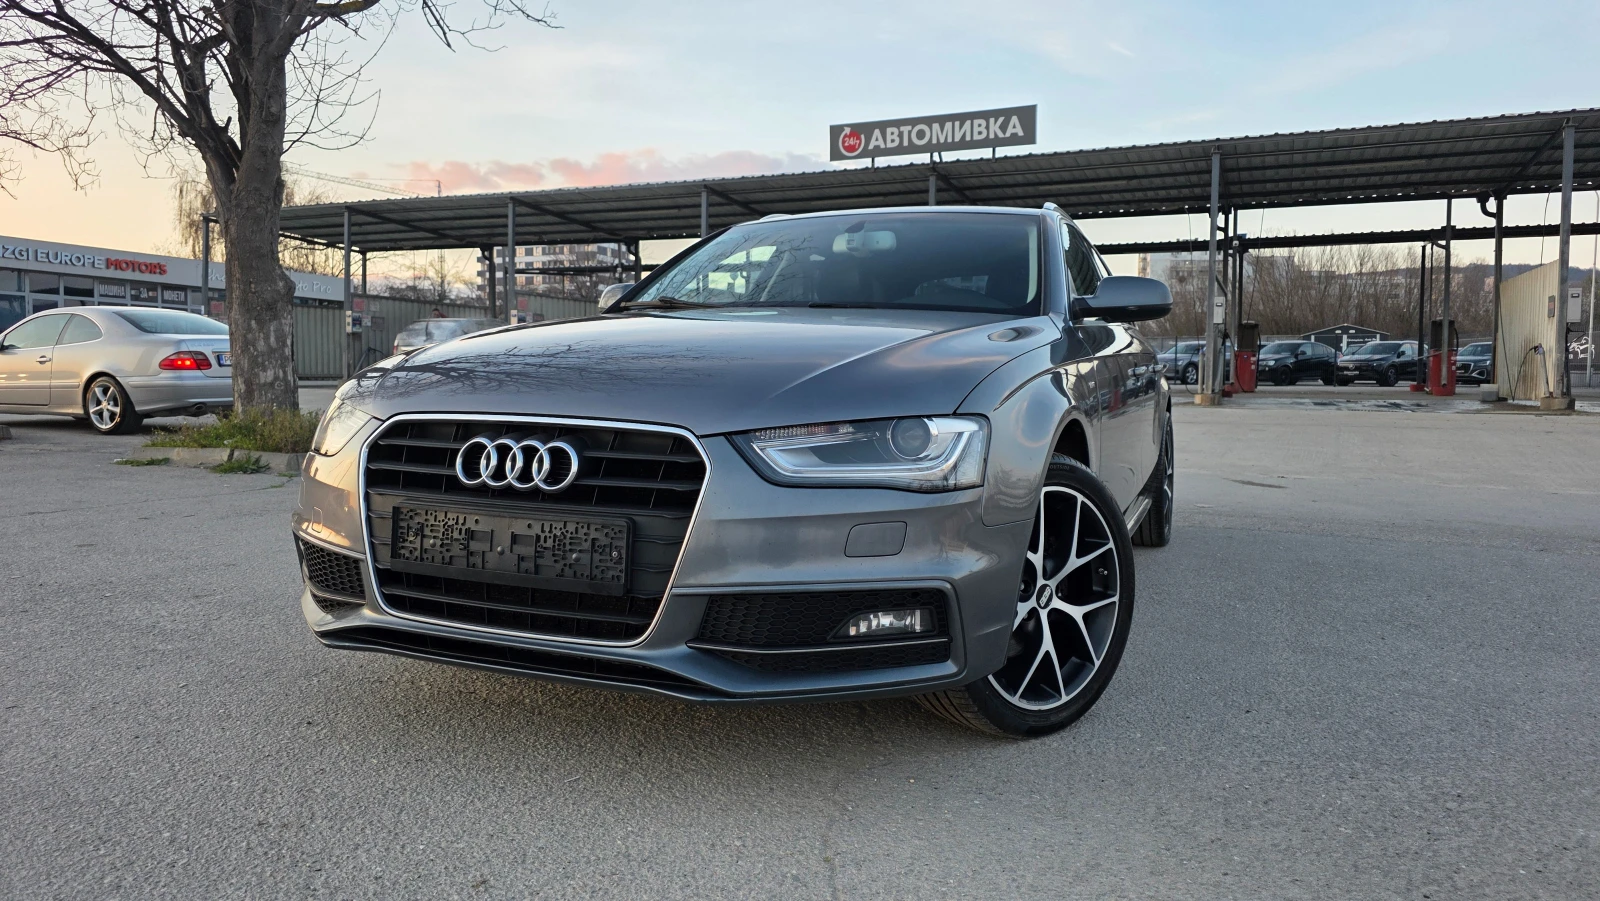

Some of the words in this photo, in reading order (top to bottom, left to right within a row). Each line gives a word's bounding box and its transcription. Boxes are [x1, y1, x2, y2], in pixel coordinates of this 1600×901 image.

[844, 136, 861, 149] 24/7
[868, 115, 1024, 150] АВТОМИВКА
[37, 249, 105, 270] EUROPE
[99, 283, 126, 297] МАШИНА
[140, 287, 148, 299] ЗА
